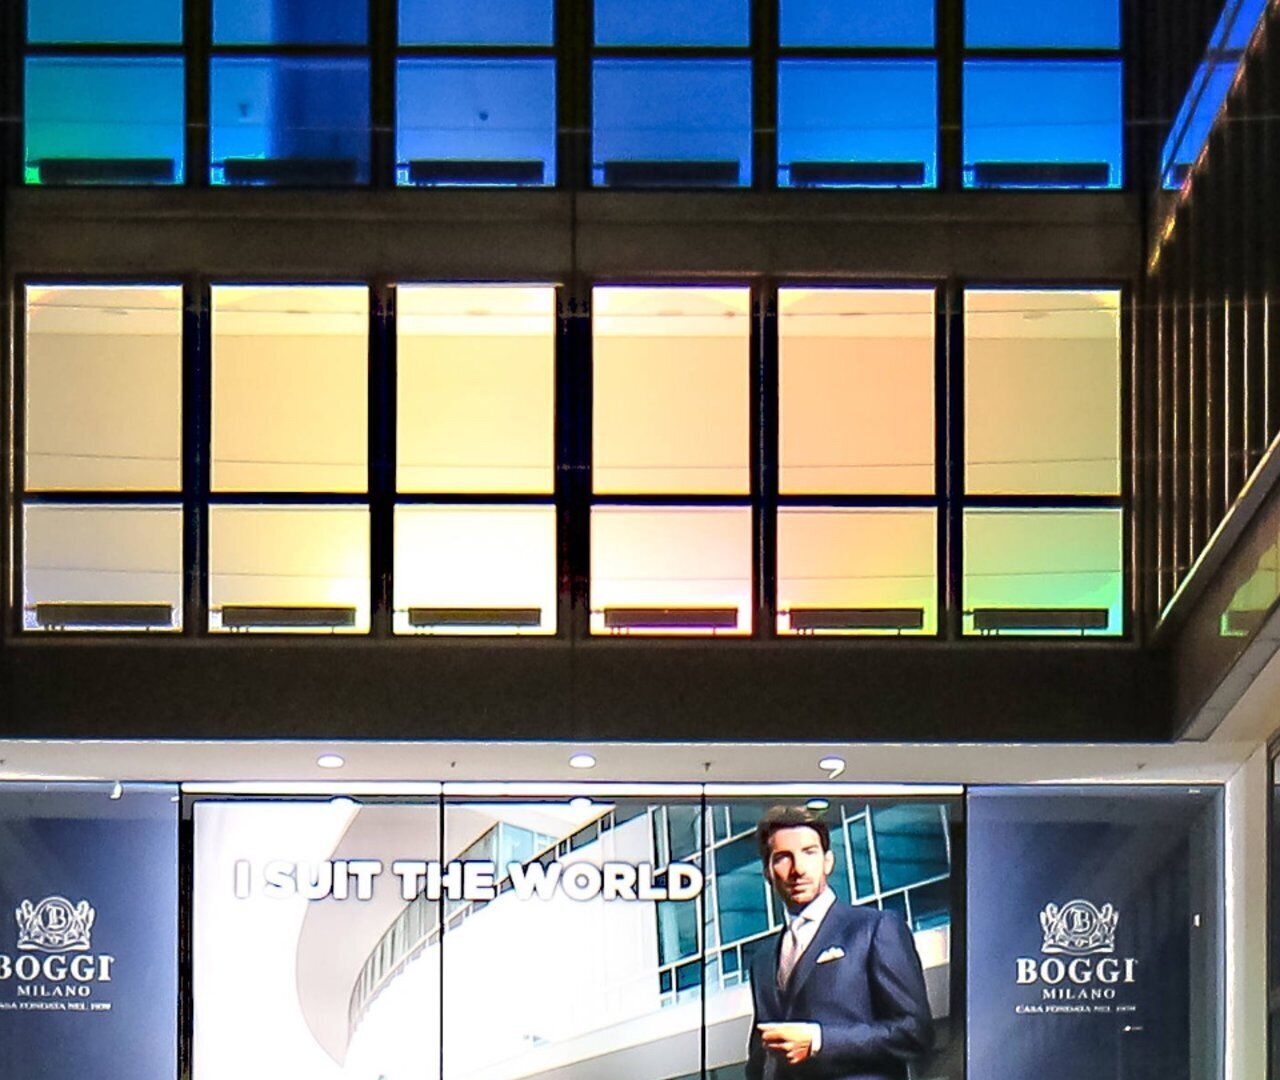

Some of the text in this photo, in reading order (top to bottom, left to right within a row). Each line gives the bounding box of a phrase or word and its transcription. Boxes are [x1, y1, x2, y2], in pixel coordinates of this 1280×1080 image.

[234, 860, 704, 902] I SUIT THE WORLD
[1016, 957, 1136, 985] BOGGI
[17, 985, 91, 997] MILANO
[1042, 988, 1116, 1000] MILANO
